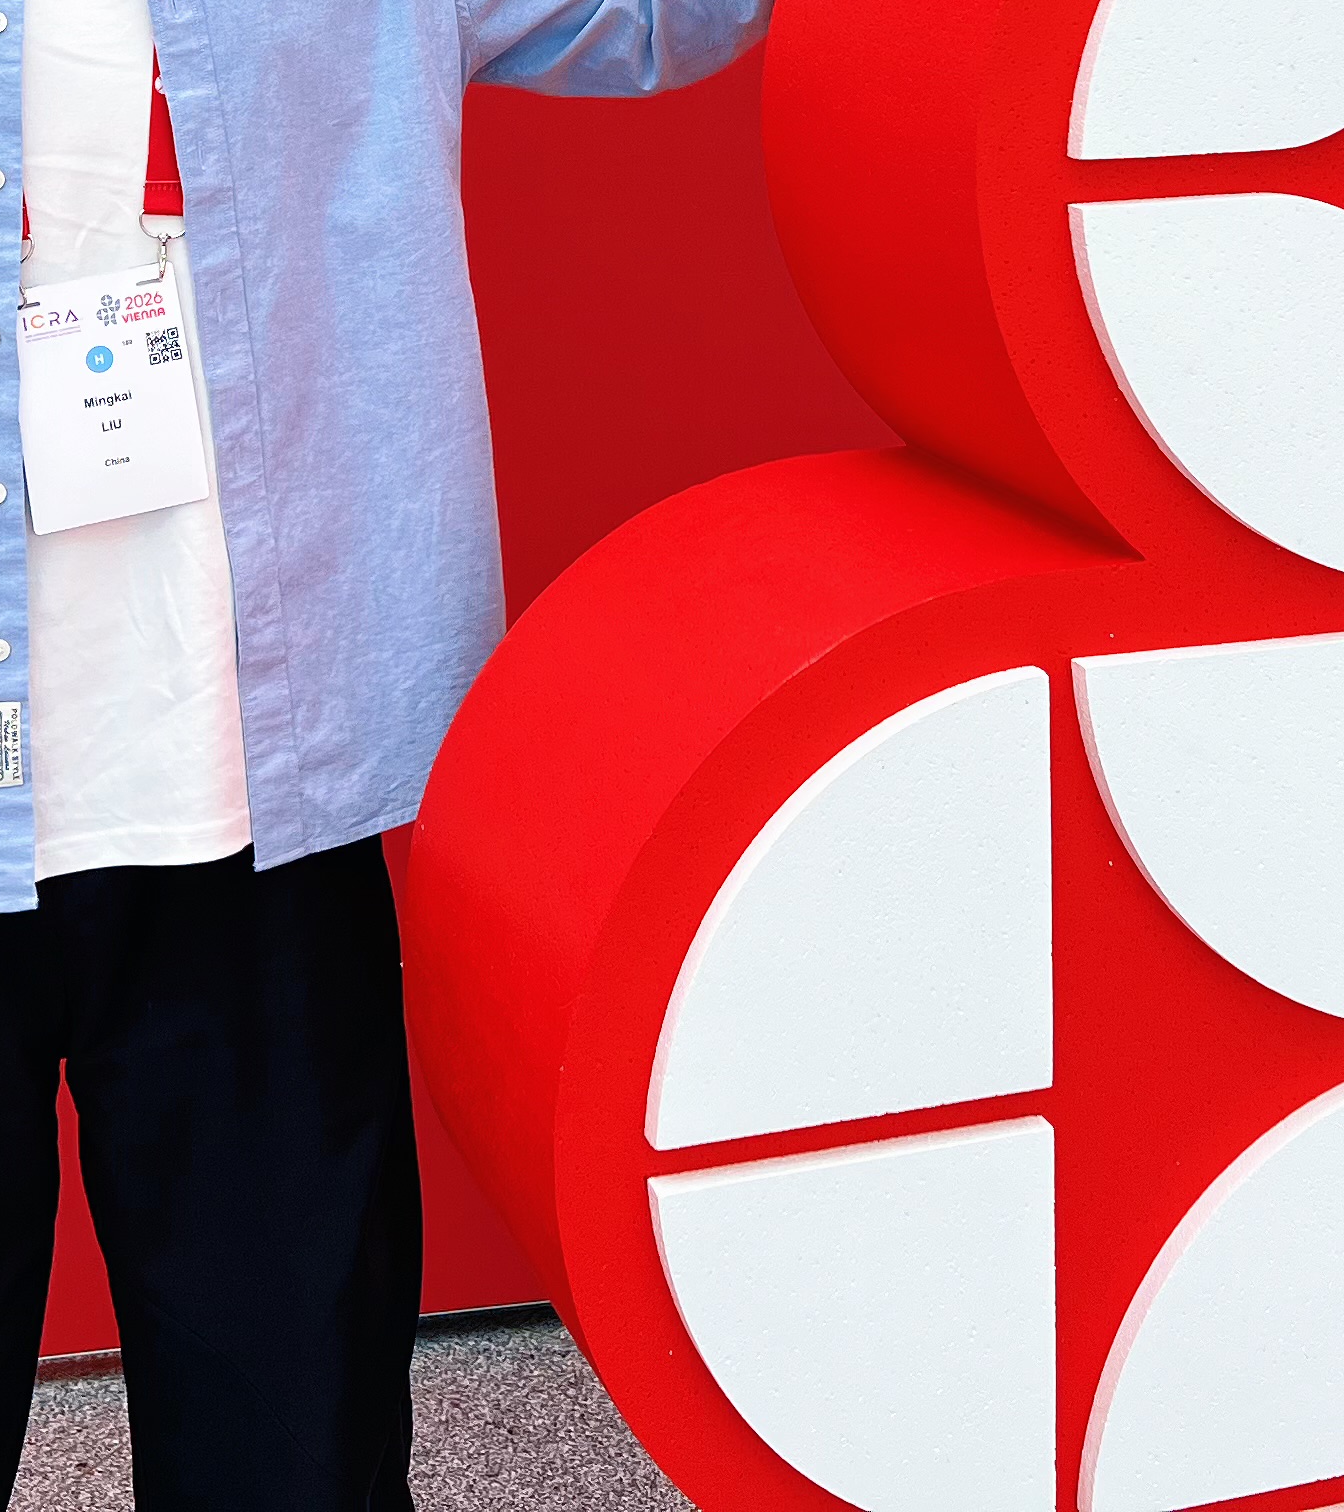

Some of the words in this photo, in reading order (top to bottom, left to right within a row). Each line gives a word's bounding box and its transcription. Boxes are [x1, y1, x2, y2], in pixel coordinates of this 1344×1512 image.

[124, 291, 164, 310] 2026
[22, 308, 80, 332] ICRA
[83, 389, 133, 409] Mingkai
[101, 418, 123, 433] LIU
